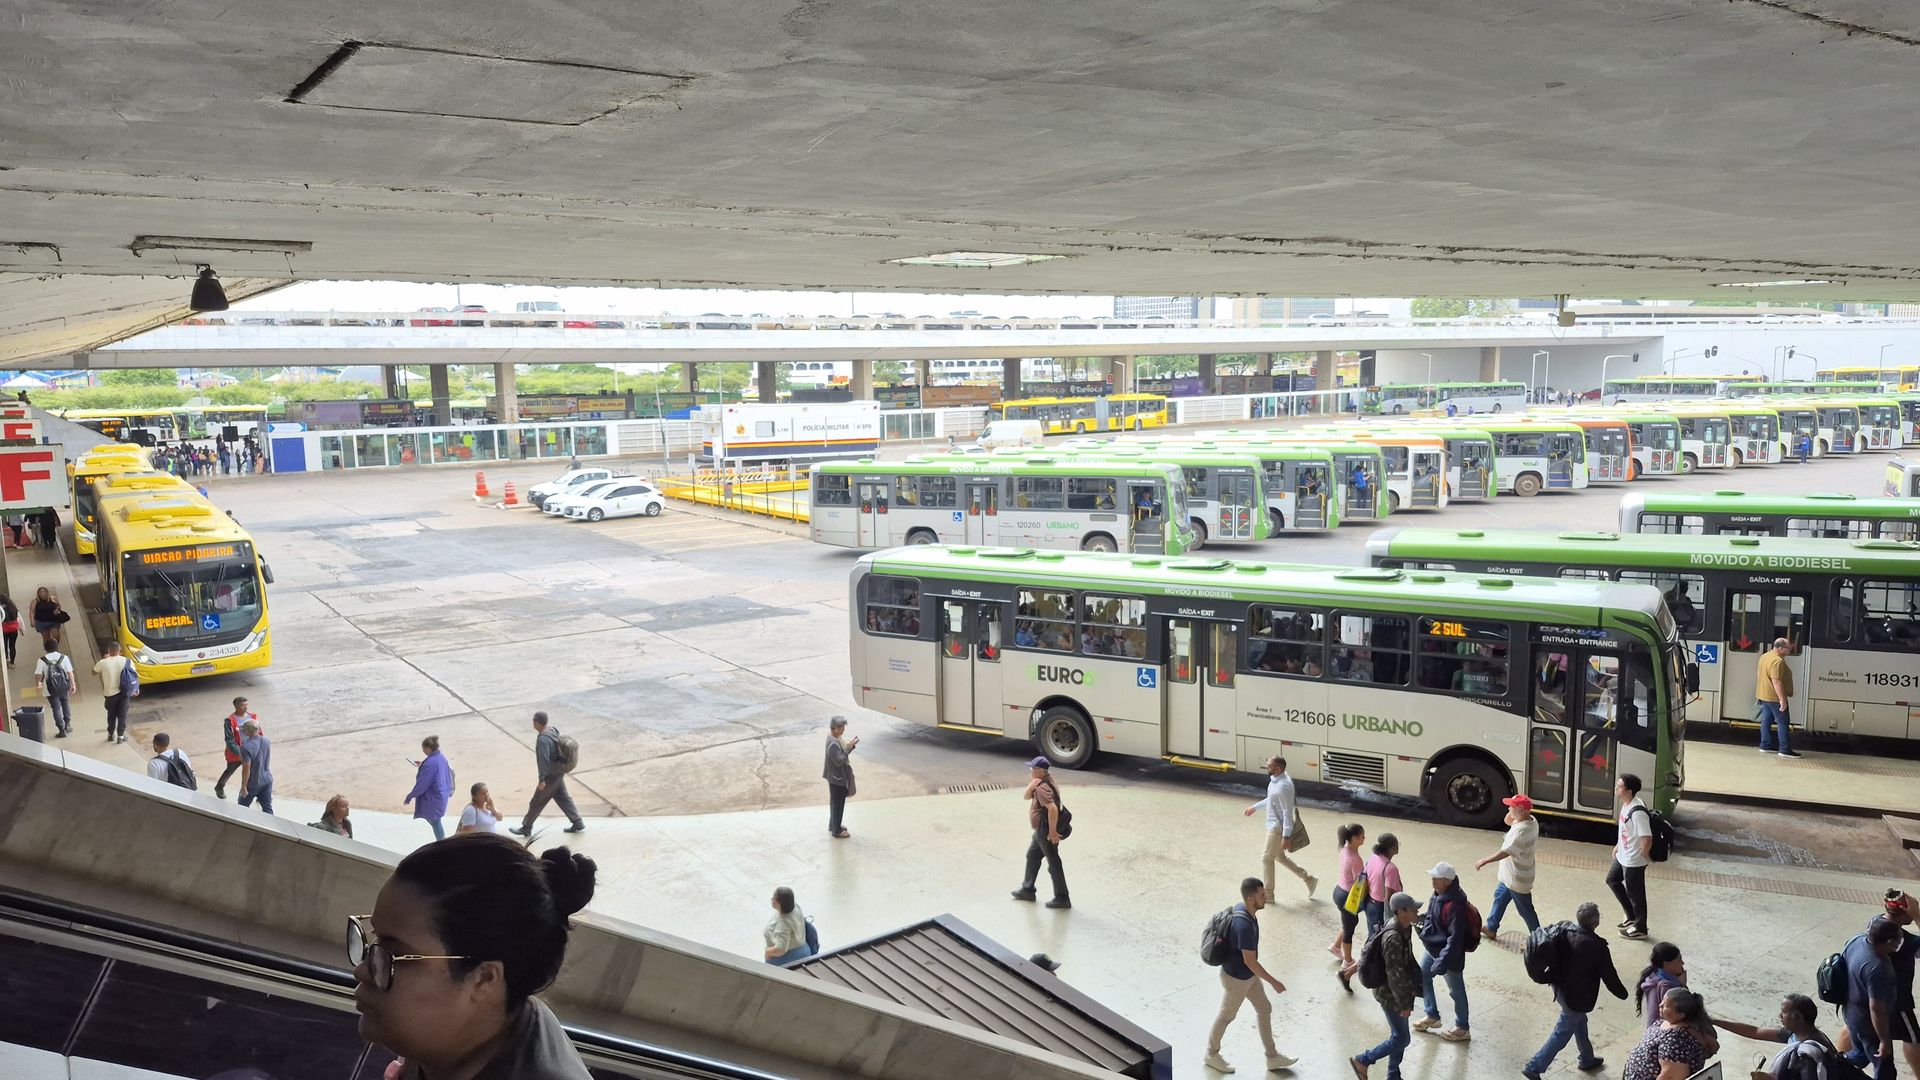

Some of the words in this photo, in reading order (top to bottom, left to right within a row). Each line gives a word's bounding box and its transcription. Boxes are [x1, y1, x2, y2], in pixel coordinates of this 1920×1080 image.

[0, 451, 54, 502] F
[1017, 521, 1041, 529] 120260
[1046, 521, 1080, 529] URBANO
[1691, 553, 1750, 566] MOVIDO
[1753, 556, 1765, 567] A
[1768, 556, 1851, 569] BIODIESEL
[1487, 566, 1505, 574] SAÍDA
[1749, 575, 1770, 584] SAÍDA
[951, 588, 967, 597] SAÍDA
[969, 590, 982, 598] EXIT
[1165, 587, 1191, 595] MOVIDO
[1198, 590, 1234, 599] BIODIESEL
[1178, 607, 1197, 615] SAÍDA
[146, 614, 194, 629] ESPECIAL
[1443, 623, 1466, 637] SUL
[1542, 635, 1575, 645] ENTRADA
[1579, 638, 1618, 648] ENTRANCE
[209, 645, 239, 657] 234320
[1864, 672, 1919, 688] 118931
[1283, 708, 1336, 727] 121606
[1342, 713, 1424, 738] URBANO
